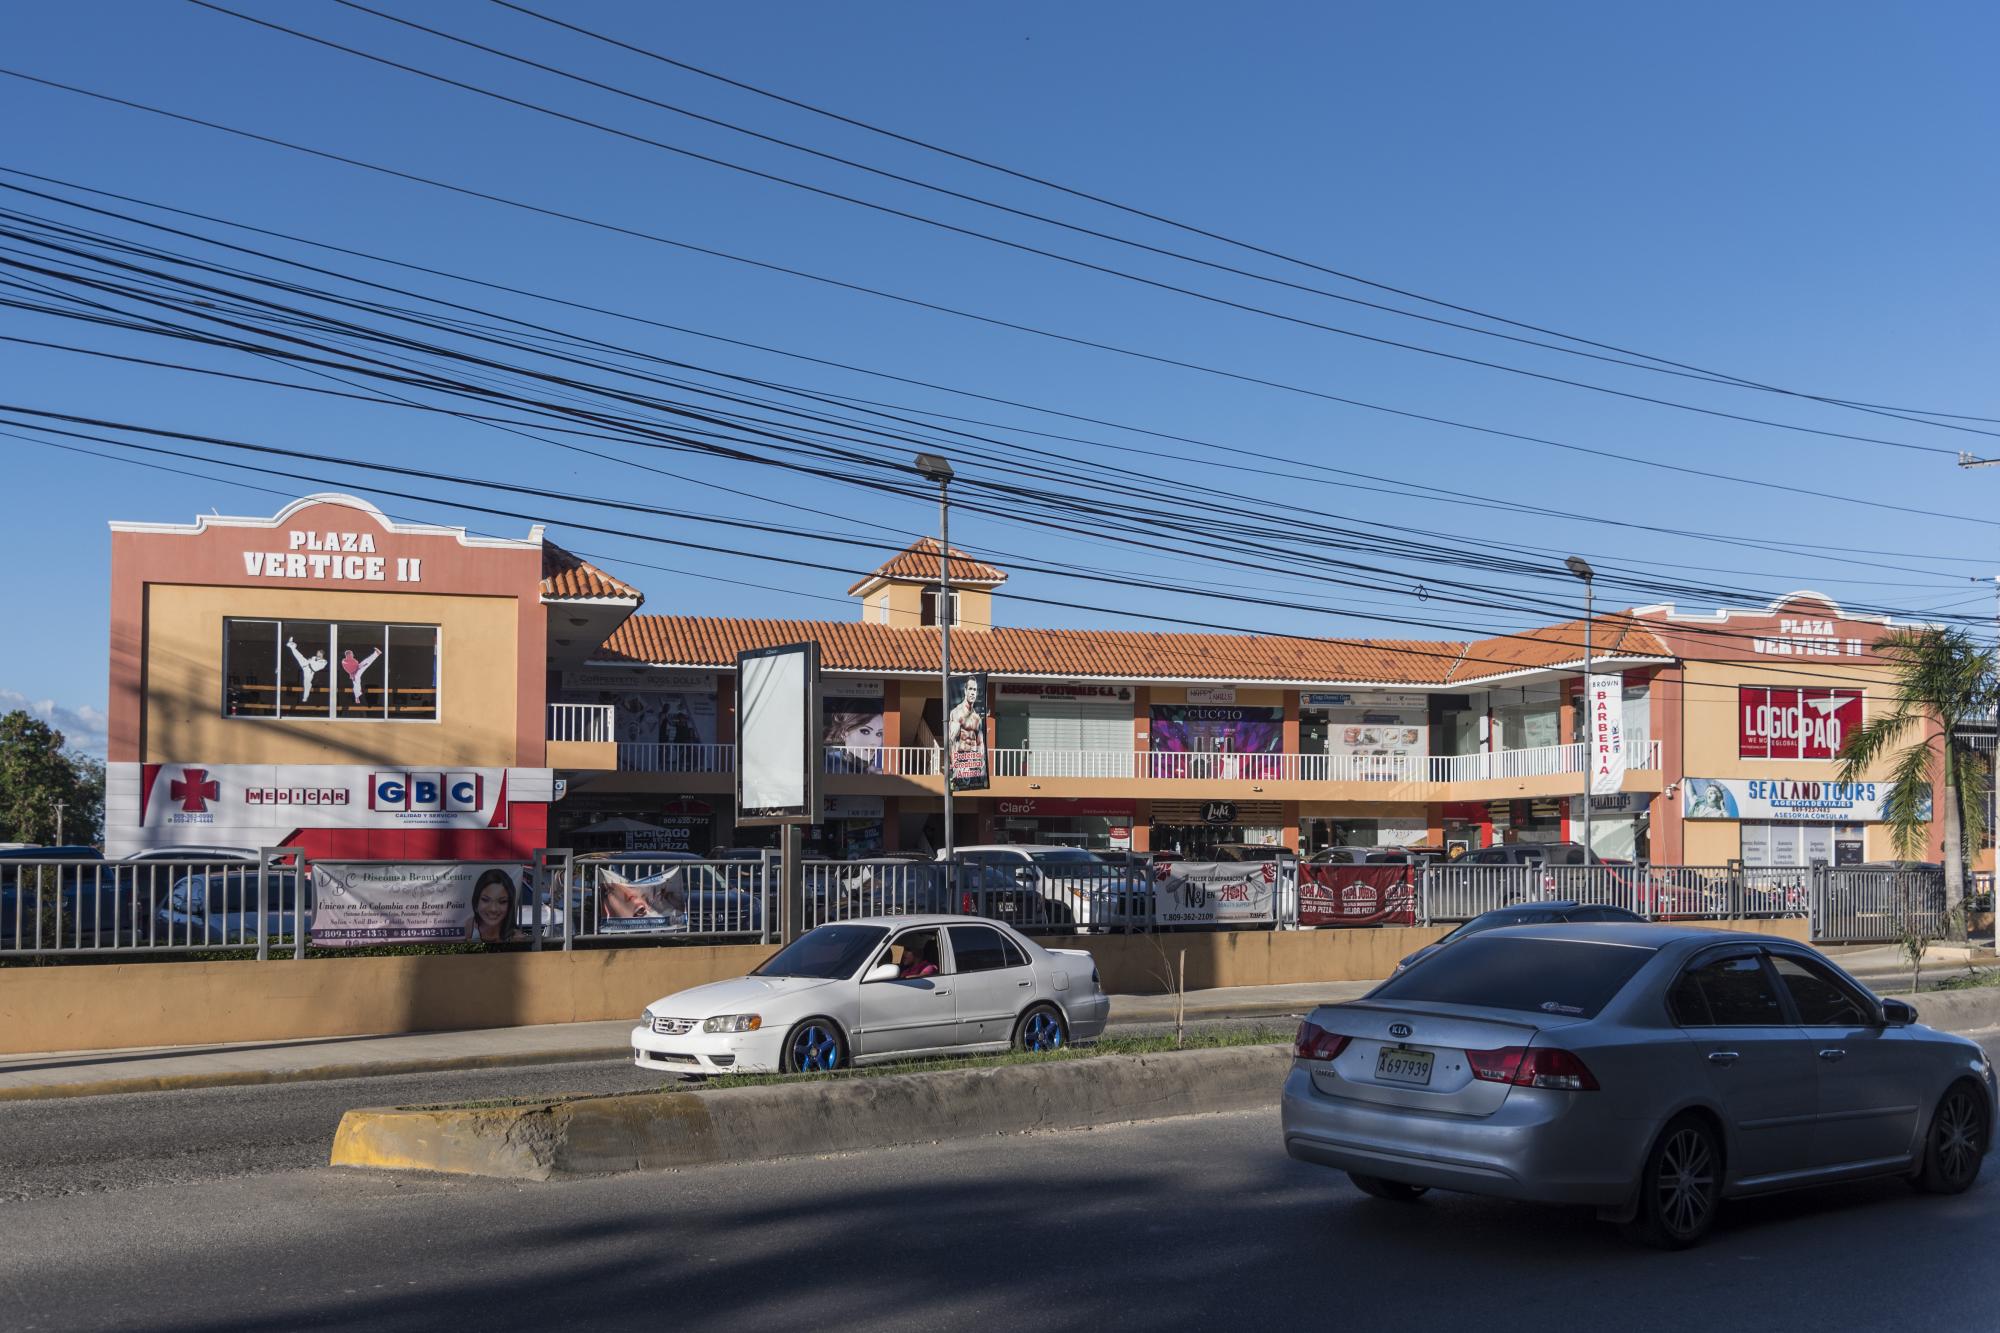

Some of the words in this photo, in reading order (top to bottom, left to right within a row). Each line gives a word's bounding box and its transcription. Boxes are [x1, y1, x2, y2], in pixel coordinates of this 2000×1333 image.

[289, 530, 376, 552] PLAZA
[243, 552, 386, 581] VERTICE
[397, 558, 421, 582] II
[1780, 619, 1834, 635] PLAZA
[1753, 636, 1840, 656] VERTICE
[1846, 638, 1862, 656] II
[1188, 709, 1242, 720] CUCCIO
[249, 791, 345, 802] MEDICAR
[377, 780, 474, 804] GBC
[999, 802, 1031, 813] Claro
[634, 828, 690, 838] CHICAGO
[634, 842, 657, 850] PAN
[660, 842, 689, 850] PIZZA
[409, 872, 438, 884] Beauty
[443, 872, 473, 882] Center
[1206, 891, 1215, 899] EN
[1391, 1024, 1409, 1036] KIA
